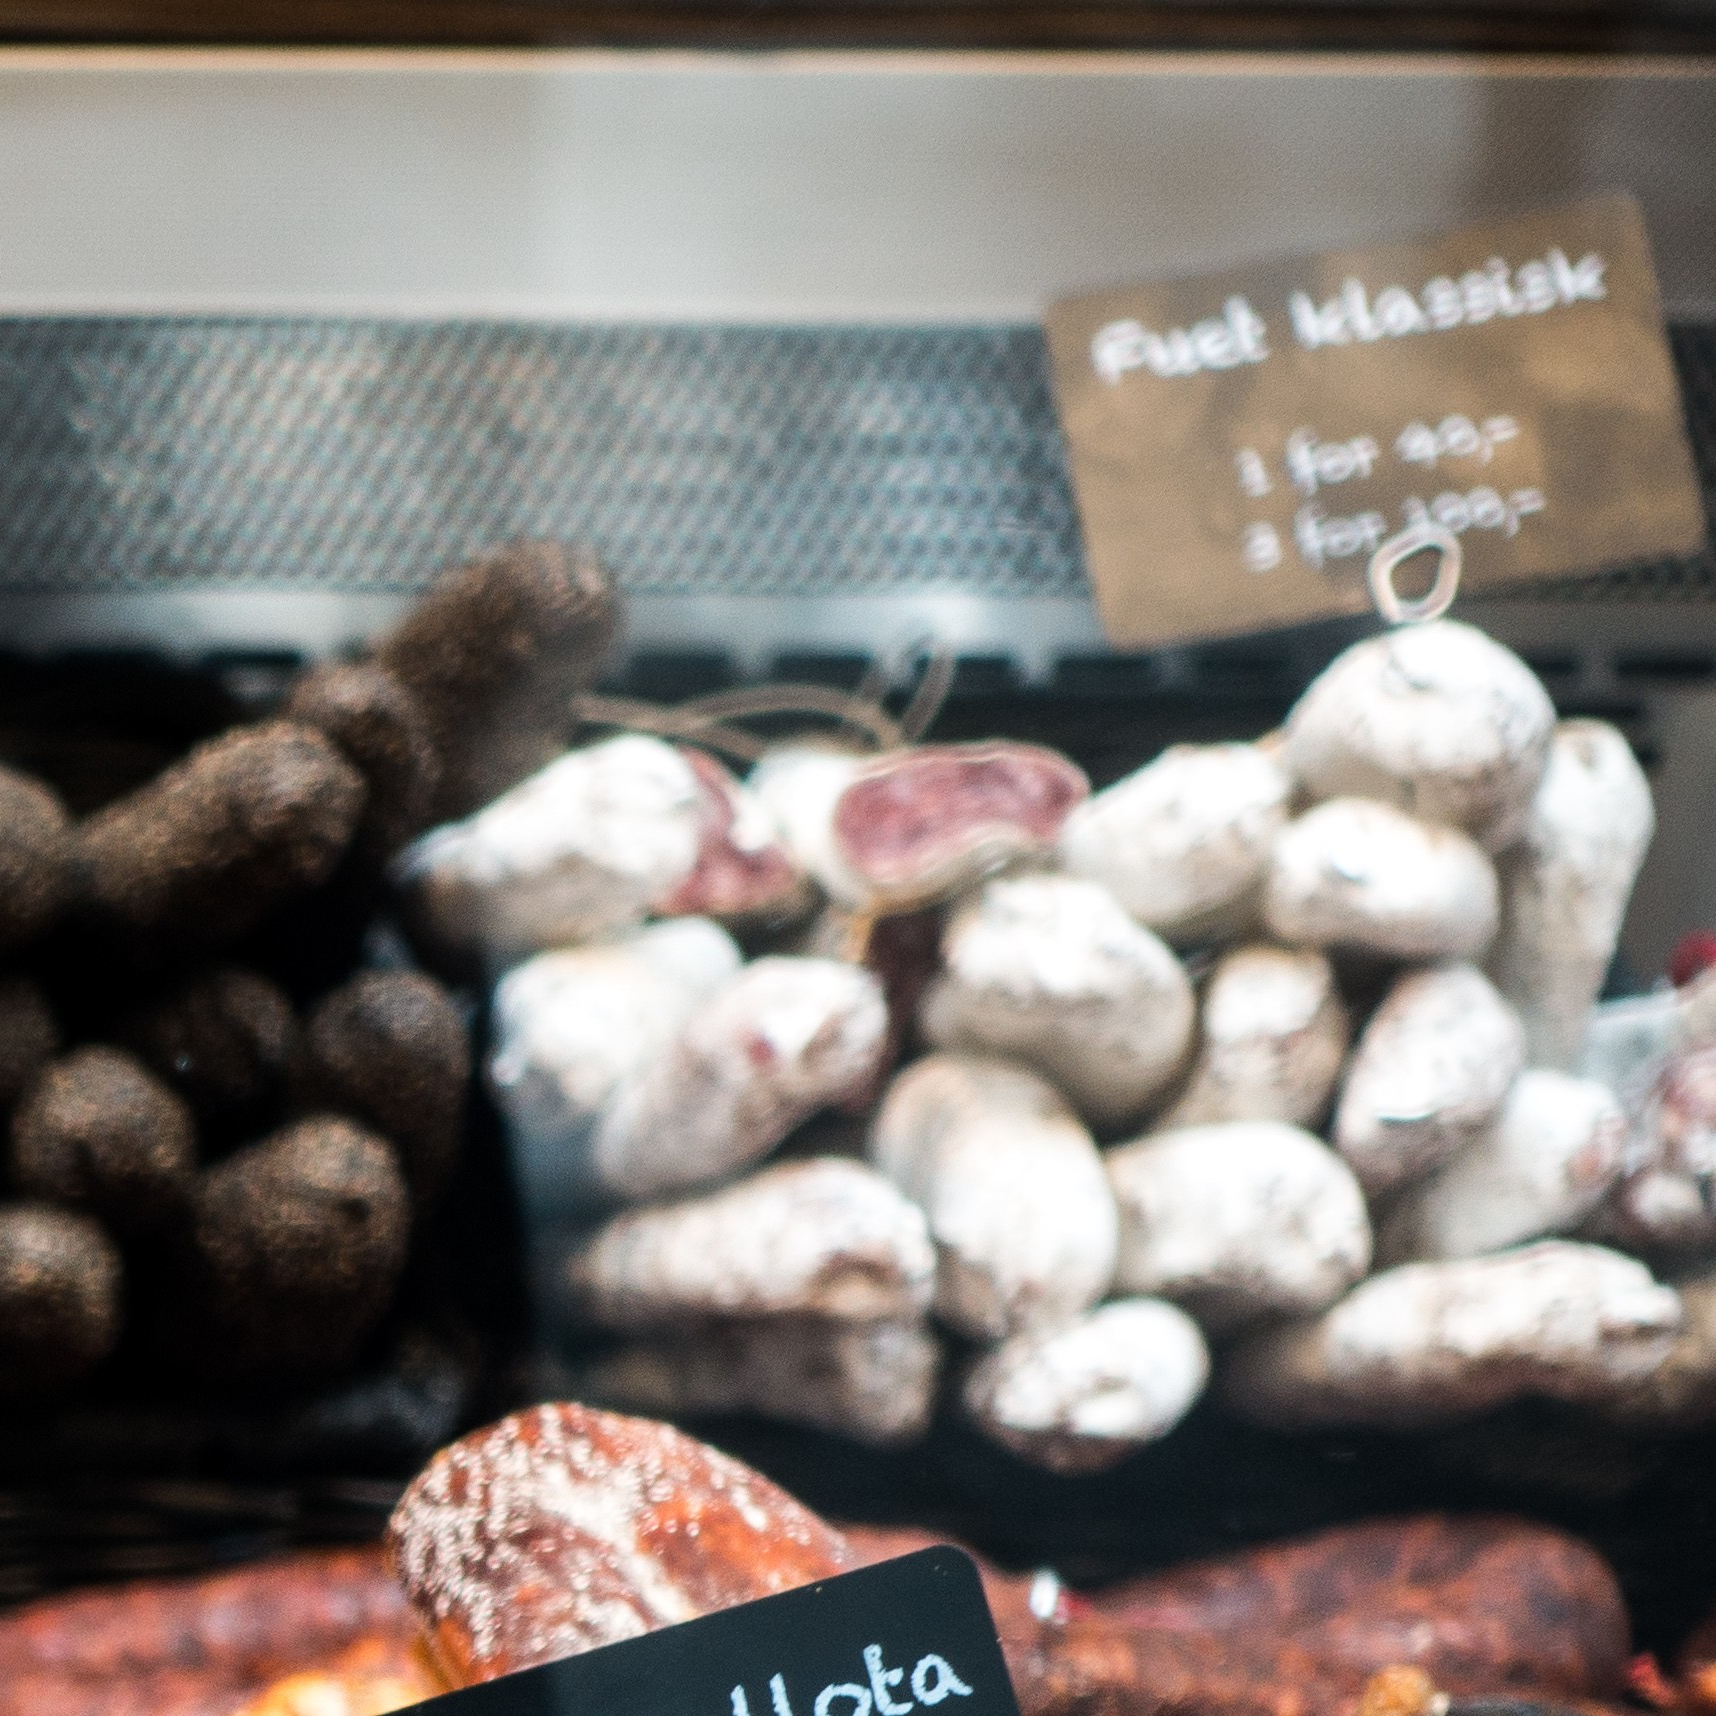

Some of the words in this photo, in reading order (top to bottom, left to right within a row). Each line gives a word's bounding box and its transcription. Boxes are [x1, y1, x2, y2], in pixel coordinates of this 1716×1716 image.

[1091, 294, 1268, 387] Fuet
[1289, 249, 1607, 350] klassisk
[1238, 448, 1268, 496] 1
[1285, 426, 1380, 495] for
[1293, 504, 1387, 569] for
